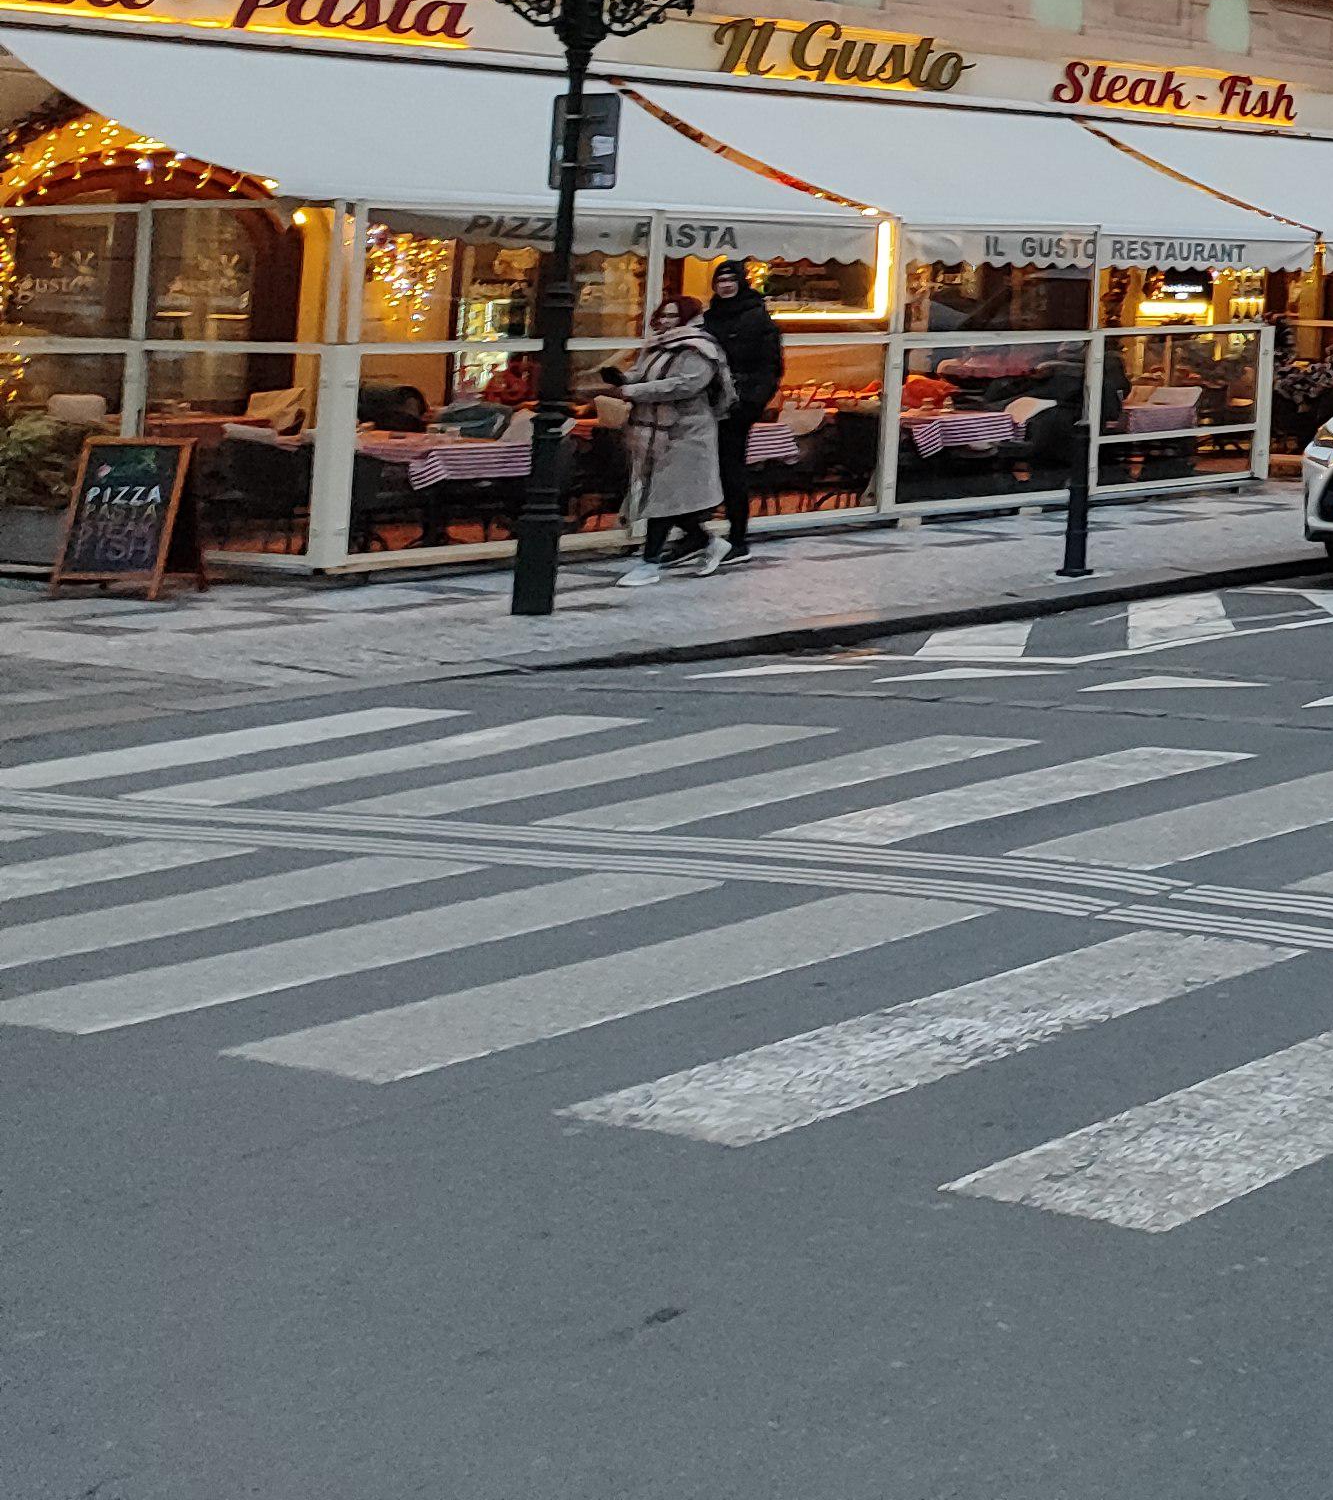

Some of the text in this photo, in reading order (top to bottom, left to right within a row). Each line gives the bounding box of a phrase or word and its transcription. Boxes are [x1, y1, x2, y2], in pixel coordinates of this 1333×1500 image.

[714, 18, 977, 92] Il Gusto
[1052, 60, 1191, 110] Steak
[1218, 75, 1297, 122] Fish
[464, 214, 556, 241] PIZZ
[985, 235, 1246, 263] IL GUSTO RESTAURANT
[85, 485, 161, 506] PIZZA
